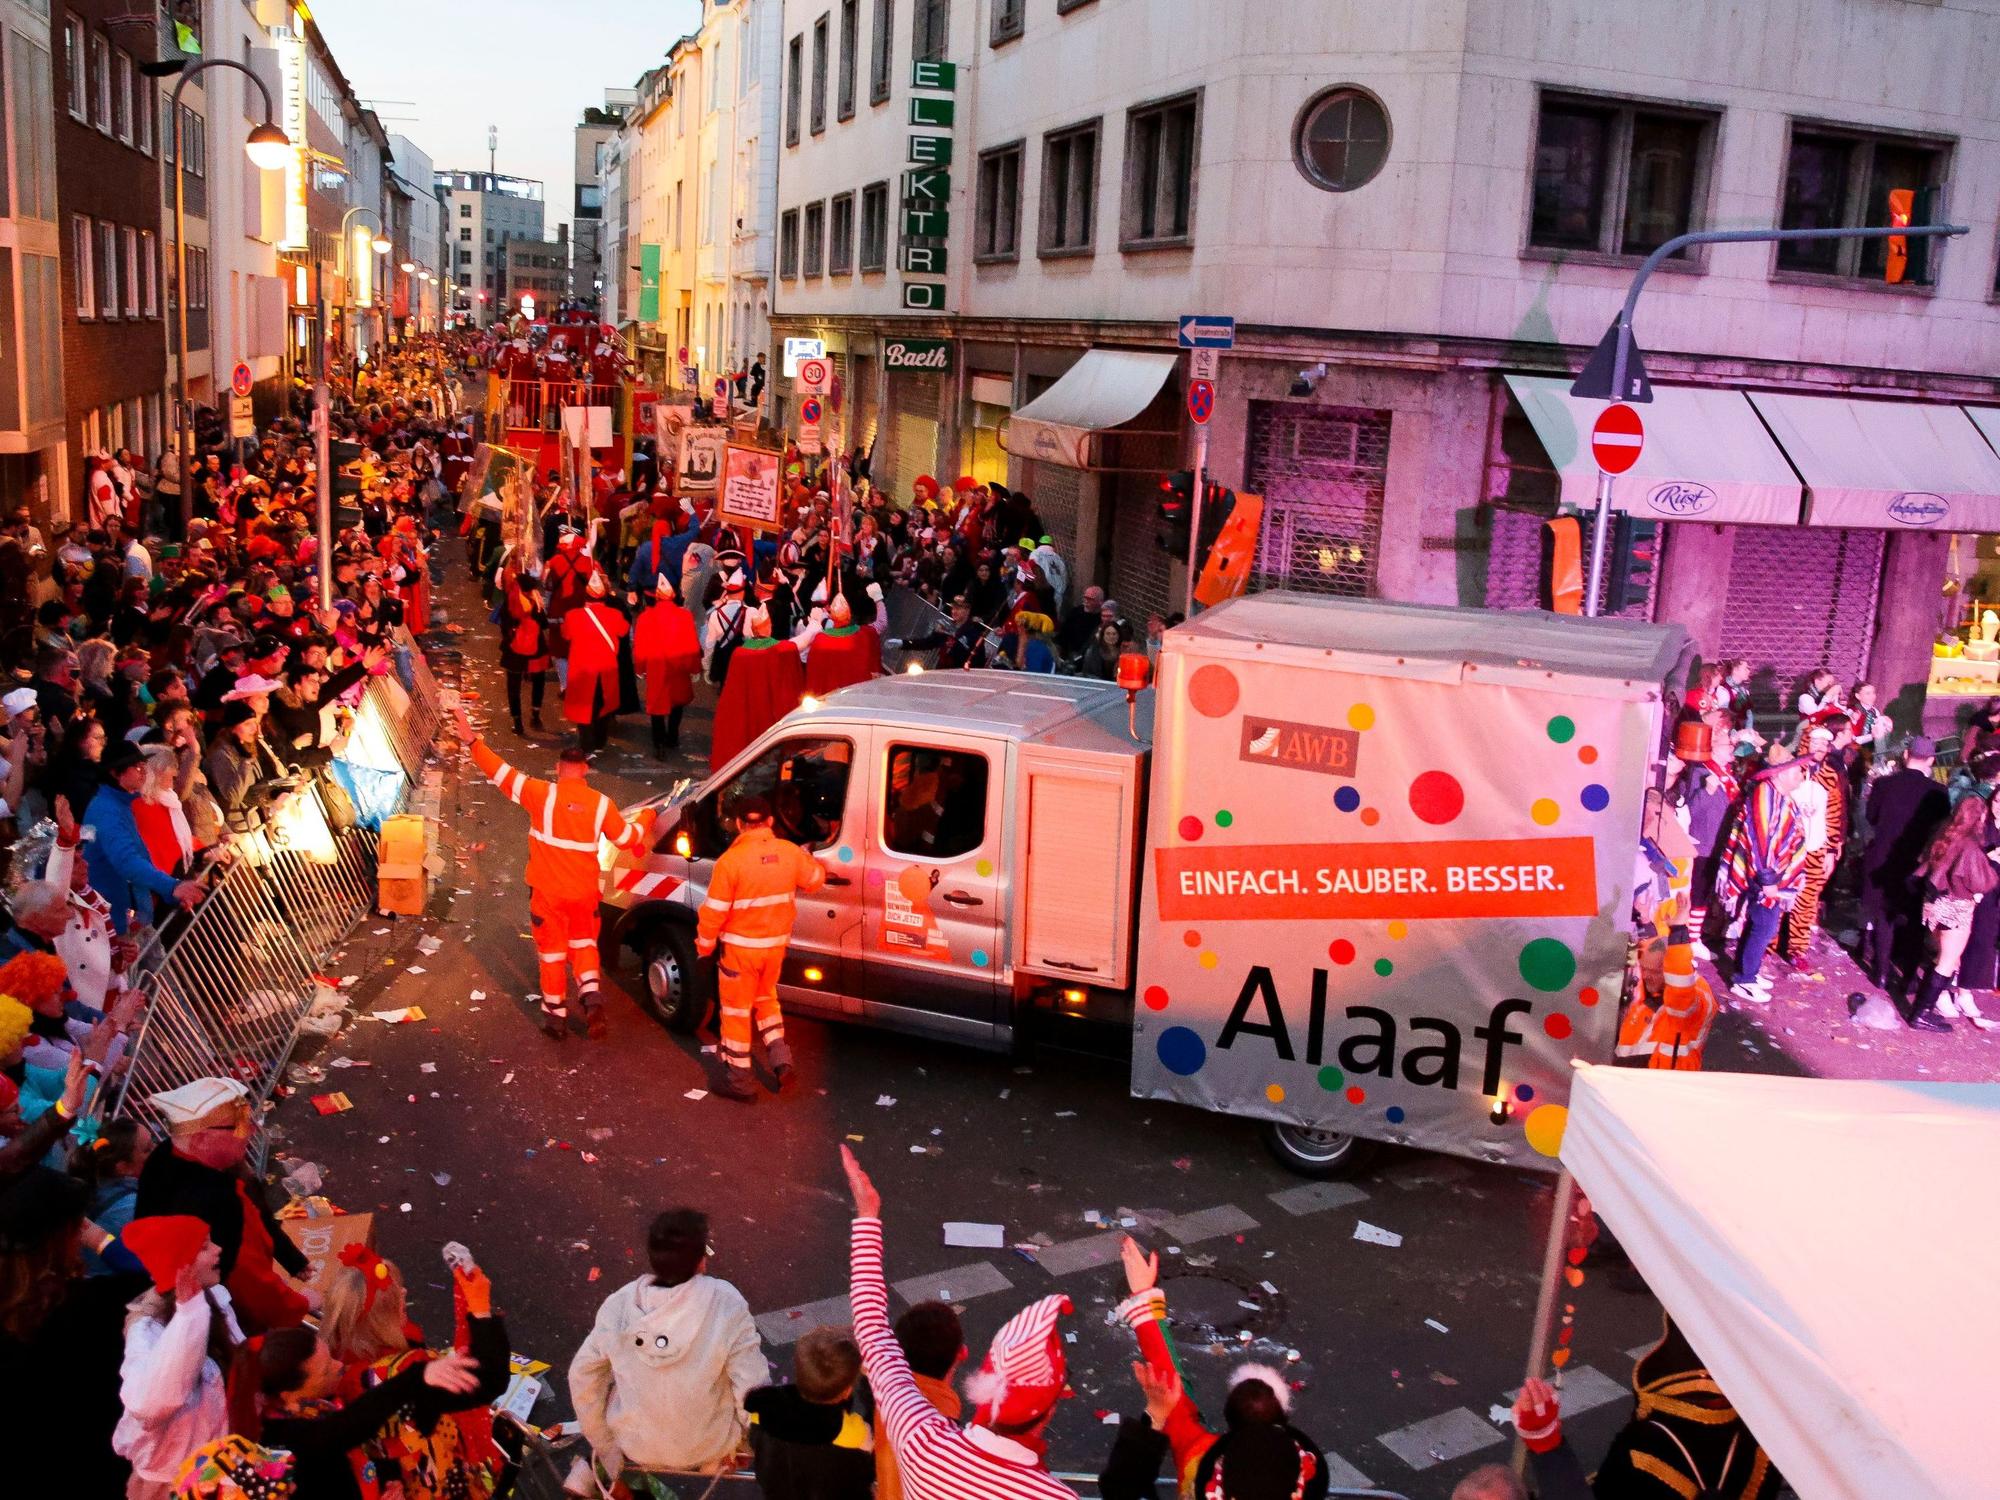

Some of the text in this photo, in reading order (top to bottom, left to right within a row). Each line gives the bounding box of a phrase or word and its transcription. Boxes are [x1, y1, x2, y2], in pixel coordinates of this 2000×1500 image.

[906, 62, 940, 308] ELEKTRO
[807, 367, 822, 379] 30
[886, 344, 948, 368] Baeth
[1283, 731, 1348, 768] AWB
[1179, 864, 1565, 896] EINFACH. SAUBER. BESSER.
[1215, 965, 1532, 1096] Alaaf
